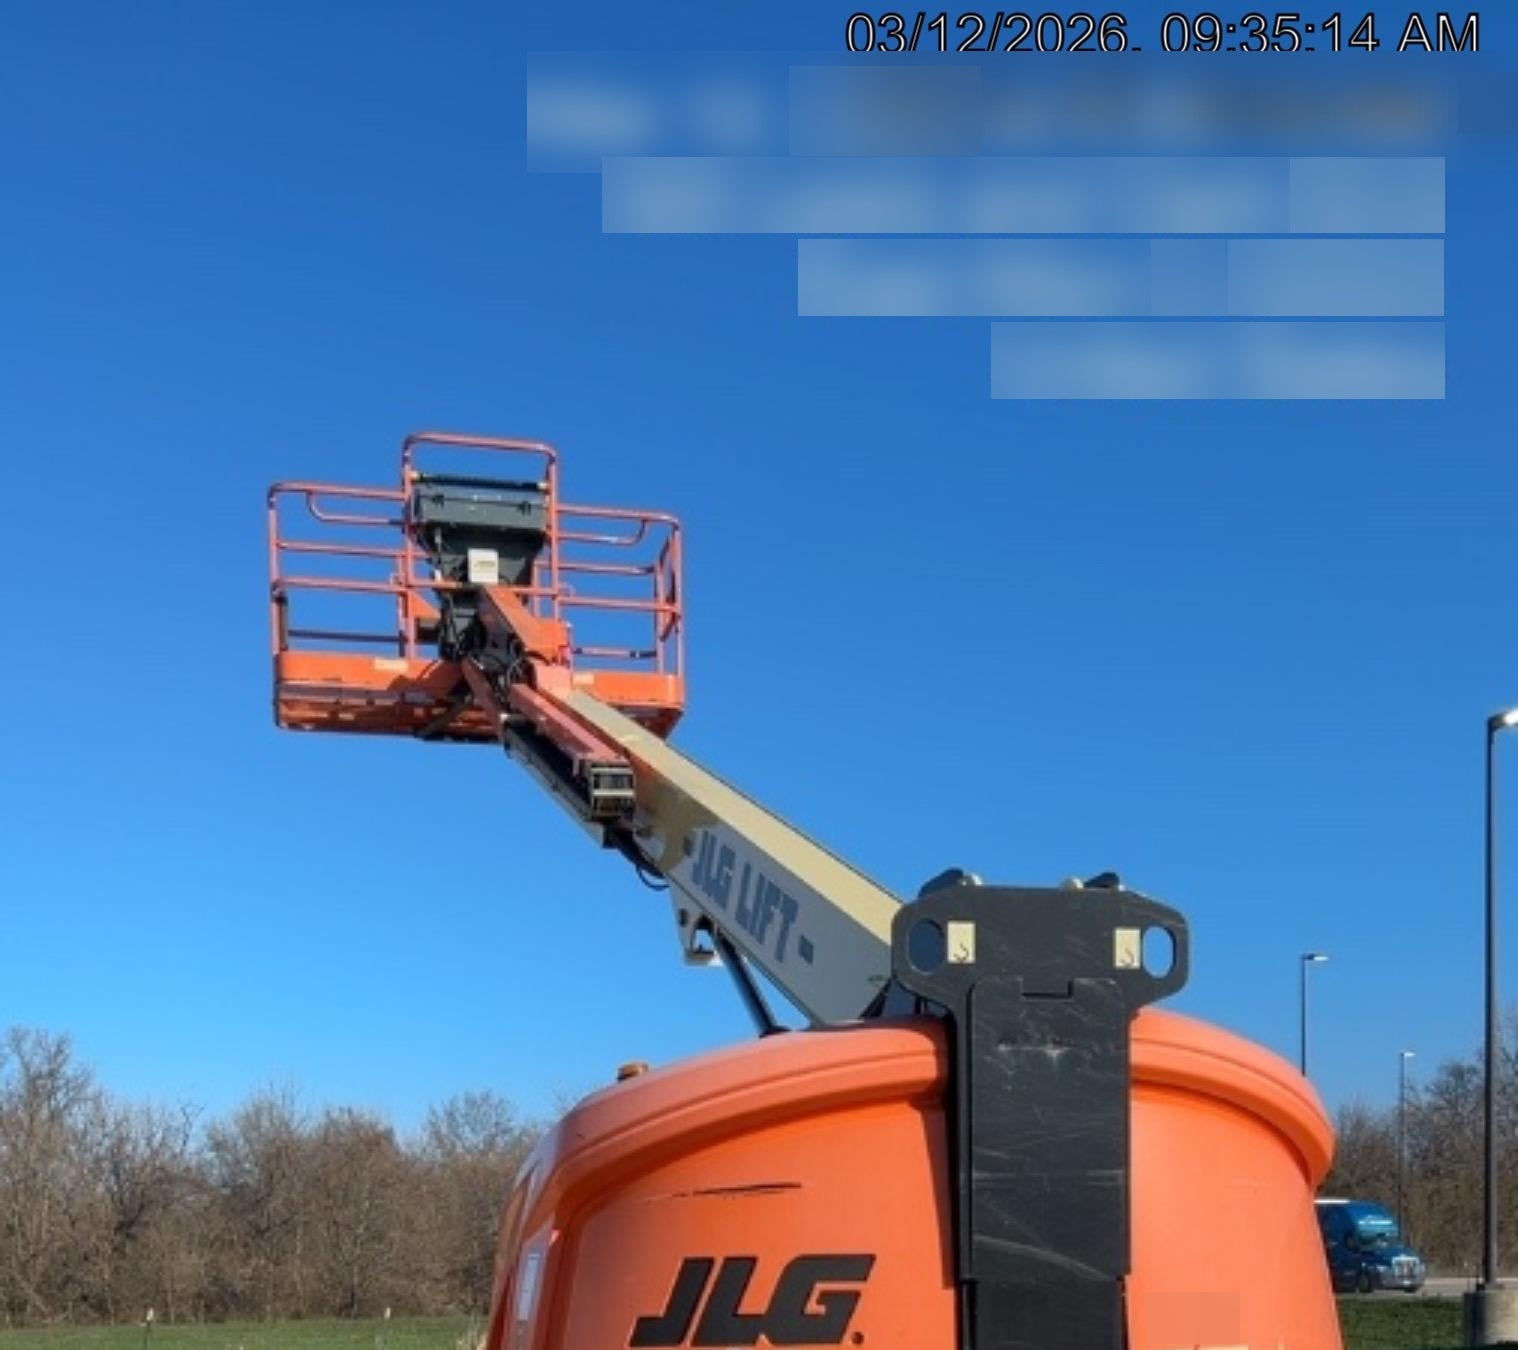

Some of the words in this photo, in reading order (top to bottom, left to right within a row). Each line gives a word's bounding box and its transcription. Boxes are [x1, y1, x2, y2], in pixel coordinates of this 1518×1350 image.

[692, 830, 736, 910] JLG
[735, 863, 798, 963] LIFT
[628, 1254, 876, 1348] JLG
